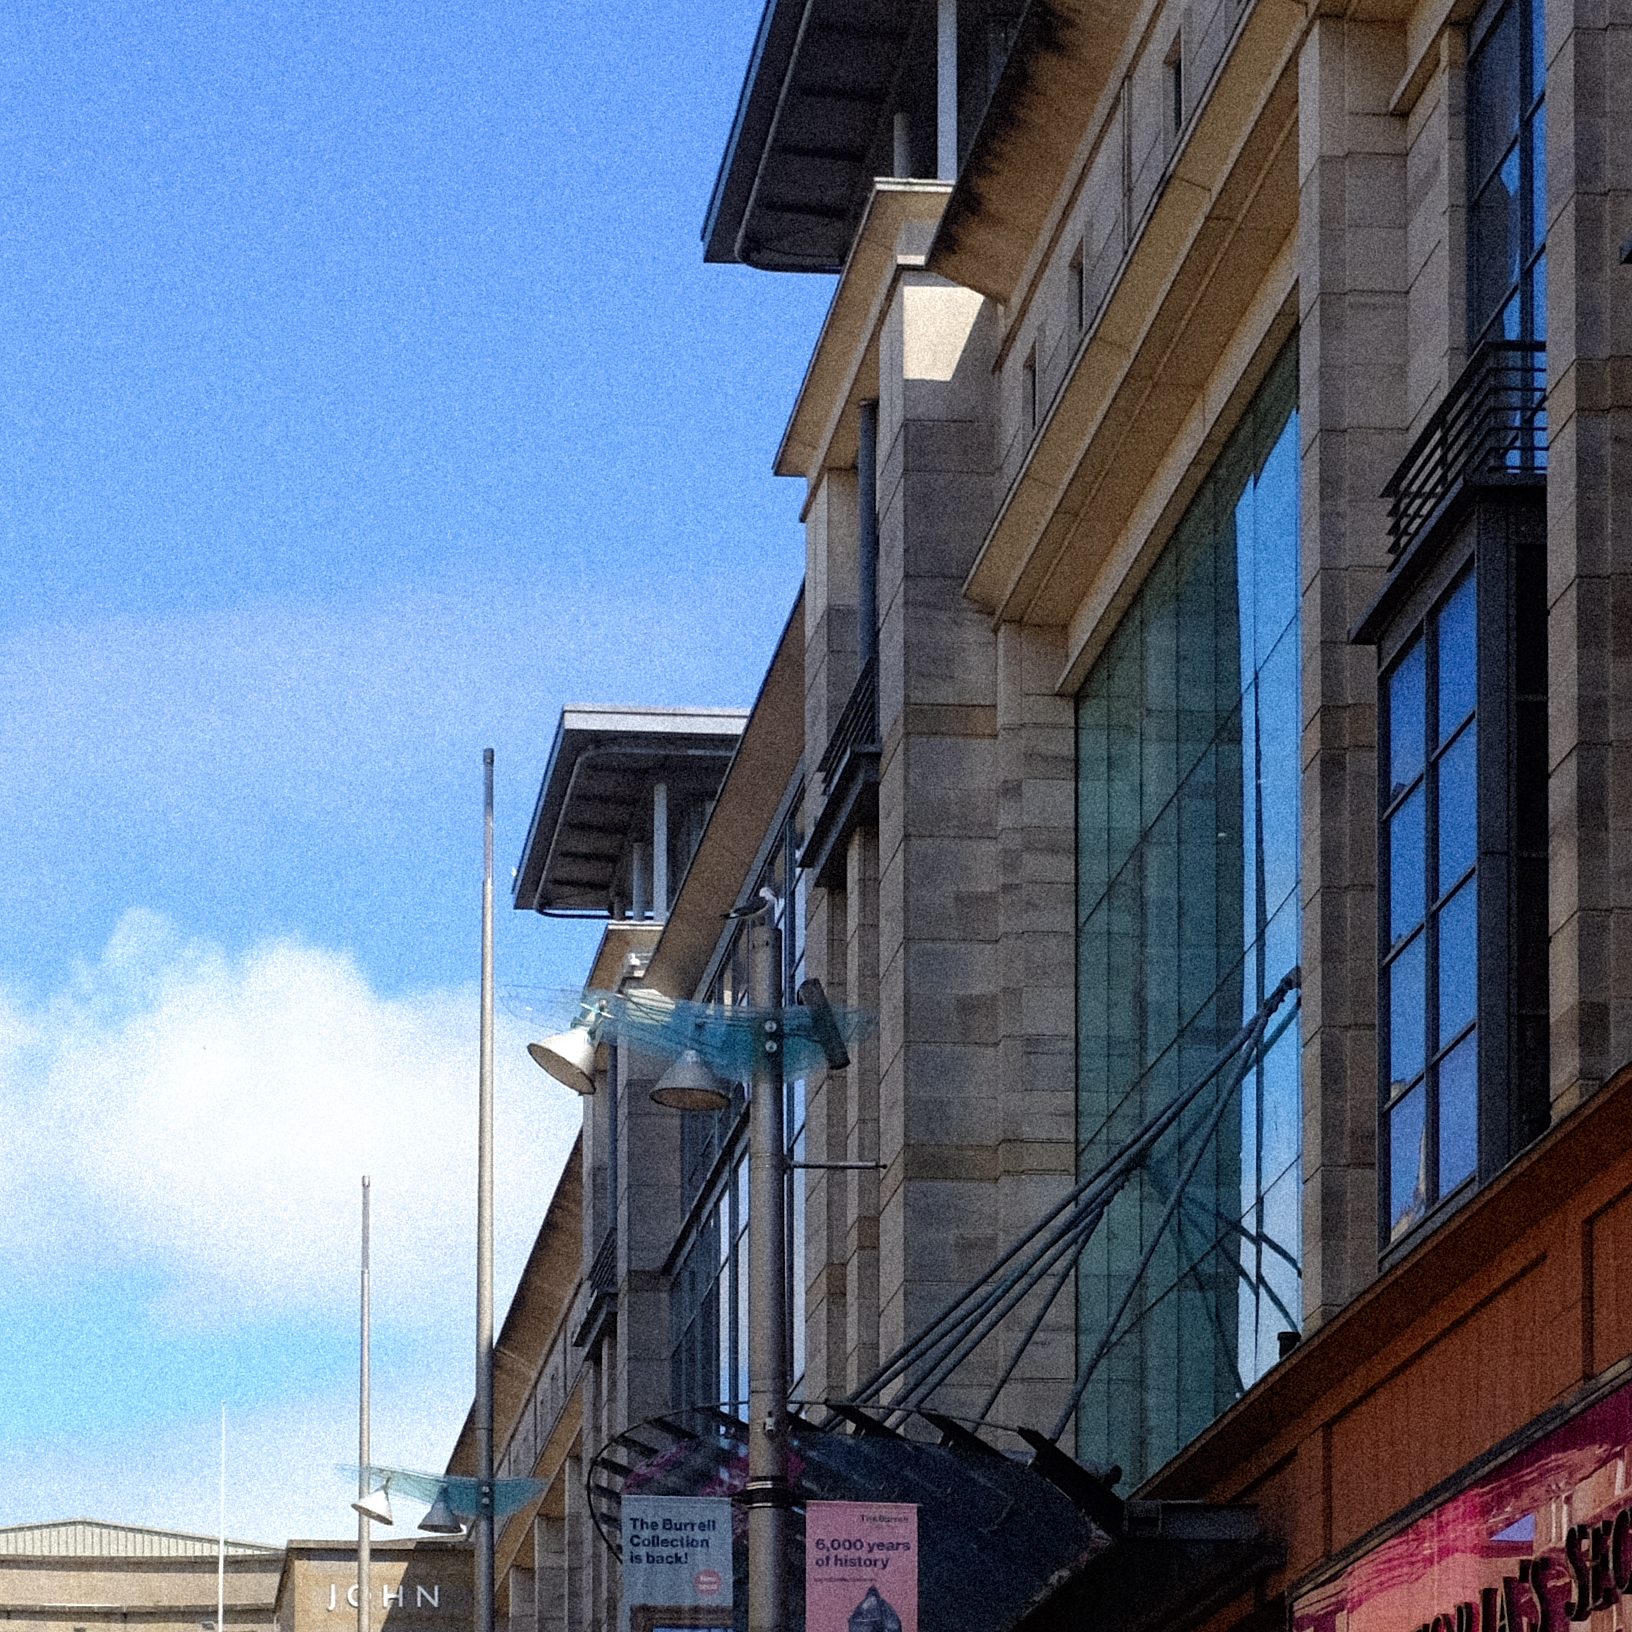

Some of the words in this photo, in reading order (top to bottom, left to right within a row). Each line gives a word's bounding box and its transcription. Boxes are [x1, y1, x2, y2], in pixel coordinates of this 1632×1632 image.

[629, 1517, 659, 1531] The
[662, 1518, 717, 1532] Burrell
[629, 1534, 710, 1549] Collection
[815, 1538, 865, 1552] 6,000
[868, 1541, 911, 1554] years
[629, 1551, 643, 1564] is
[646, 1551, 688, 1565] back!
[815, 1554, 831, 1568] of
[834, 1555, 890, 1570] history
[327, 1584, 440, 1611] JOHN
